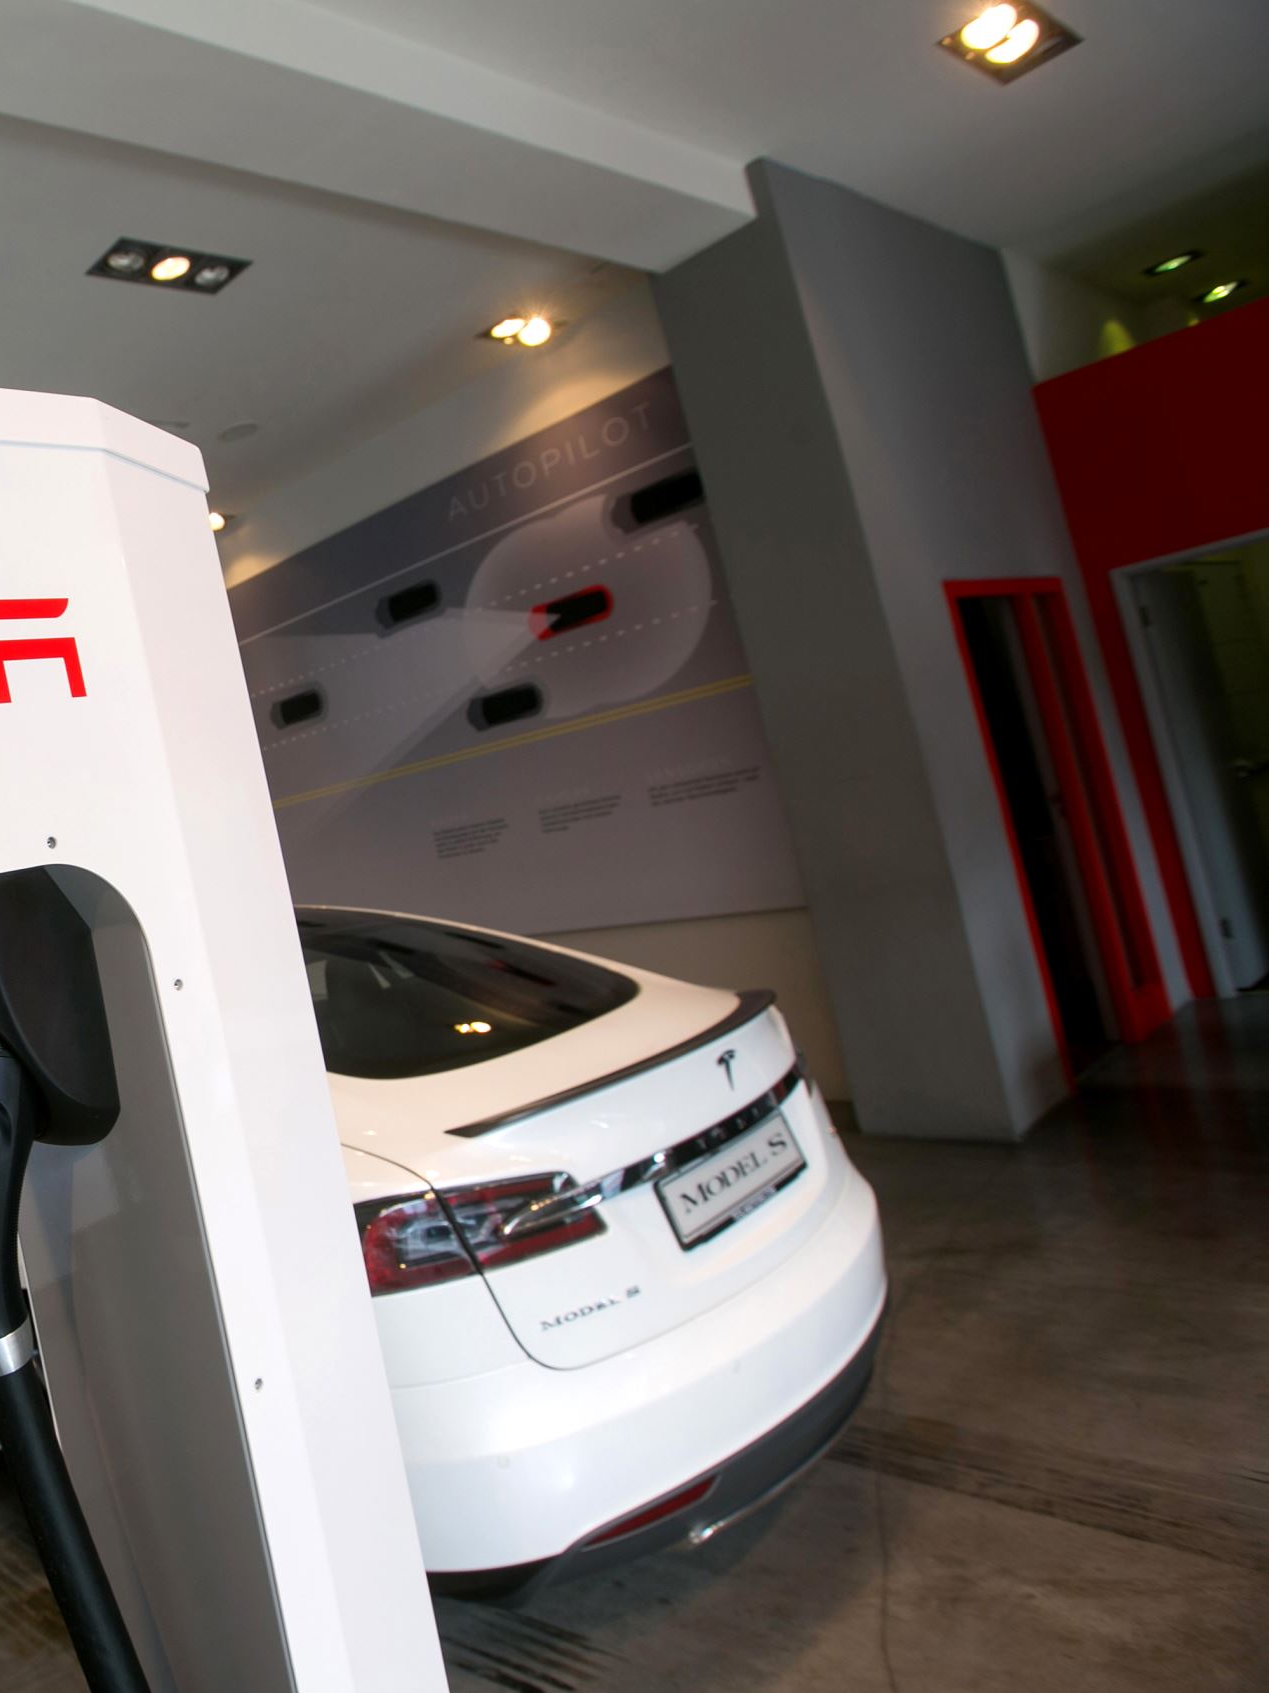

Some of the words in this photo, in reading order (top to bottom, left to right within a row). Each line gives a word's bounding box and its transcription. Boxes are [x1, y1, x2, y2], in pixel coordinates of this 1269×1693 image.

[447, 402, 651, 523] AUTOPILOT
[679, 1149, 769, 1215] MODEL
[766, 1132, 788, 1157] S
[540, 1297, 622, 1332] MODEL
[625, 1284, 642, 1299] S
